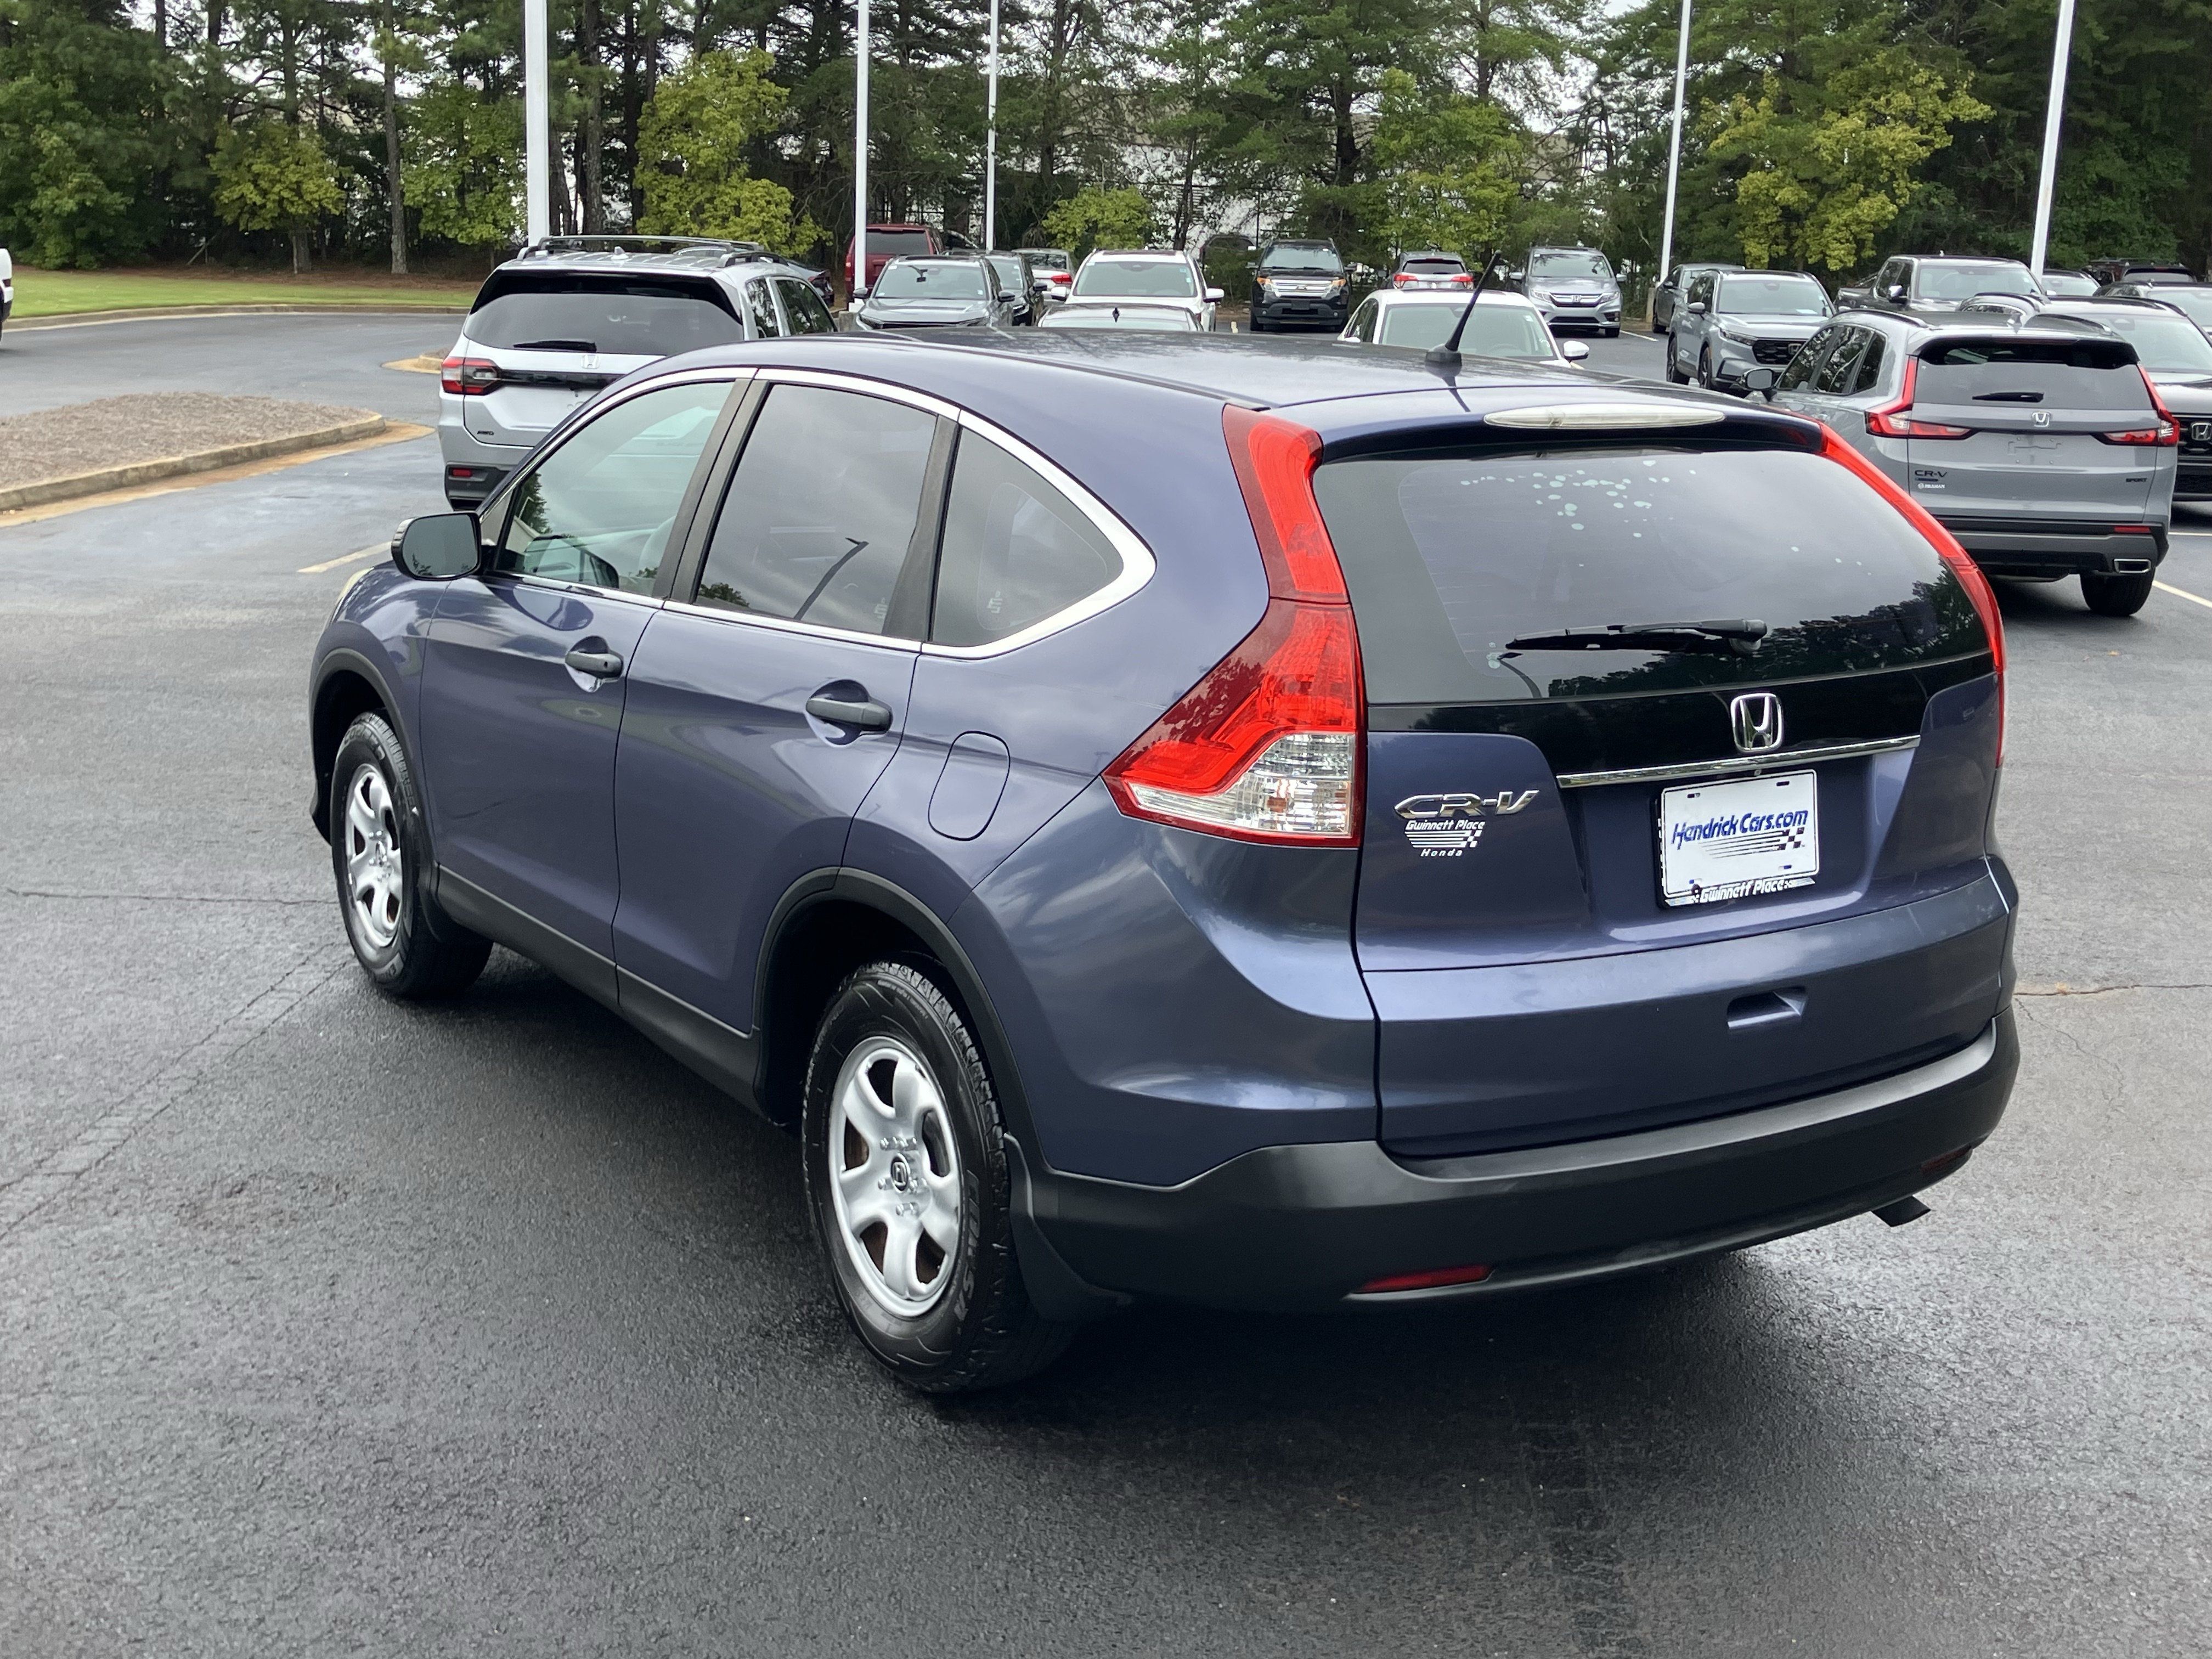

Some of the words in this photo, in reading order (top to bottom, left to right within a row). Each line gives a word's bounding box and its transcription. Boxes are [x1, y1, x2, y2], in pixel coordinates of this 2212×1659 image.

[1393, 790, 1539, 819] CR-V
[1406, 820, 1454, 830] Gwinnett
[1455, 820, 1486, 830] Place
[1420, 849, 1463, 857] Honda
[1701, 879, 1754, 903] Gwinnett
[1753, 878, 1784, 895] Place
